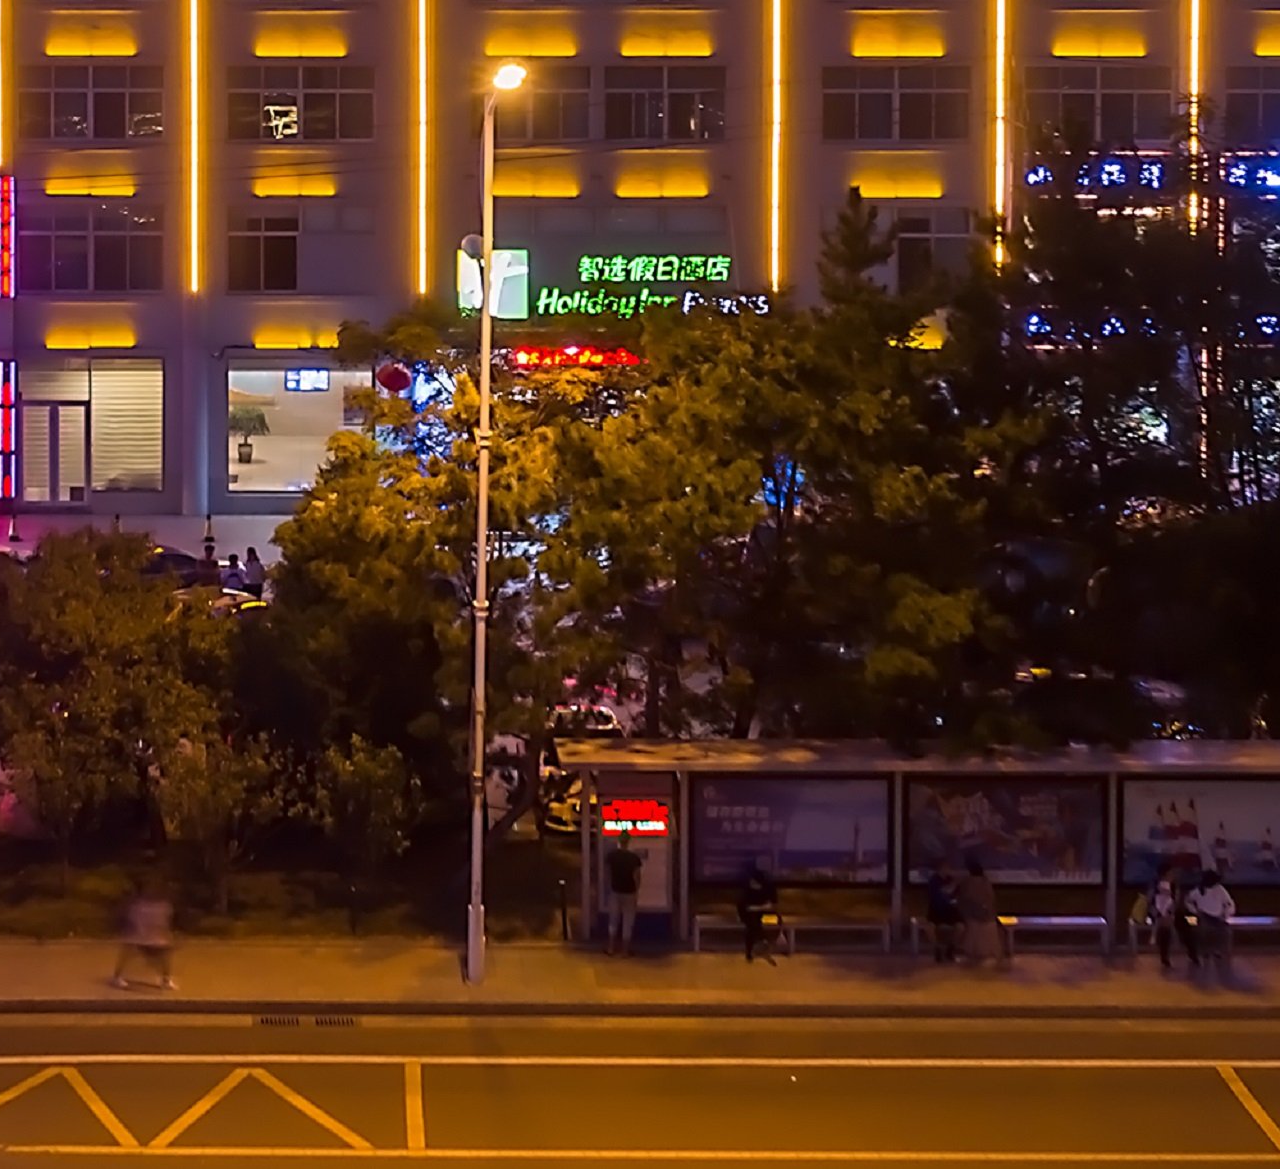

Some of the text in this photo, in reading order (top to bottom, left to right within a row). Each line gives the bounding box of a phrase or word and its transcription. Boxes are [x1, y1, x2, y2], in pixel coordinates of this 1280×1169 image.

[578, 254, 732, 282] 智选假日酒店
